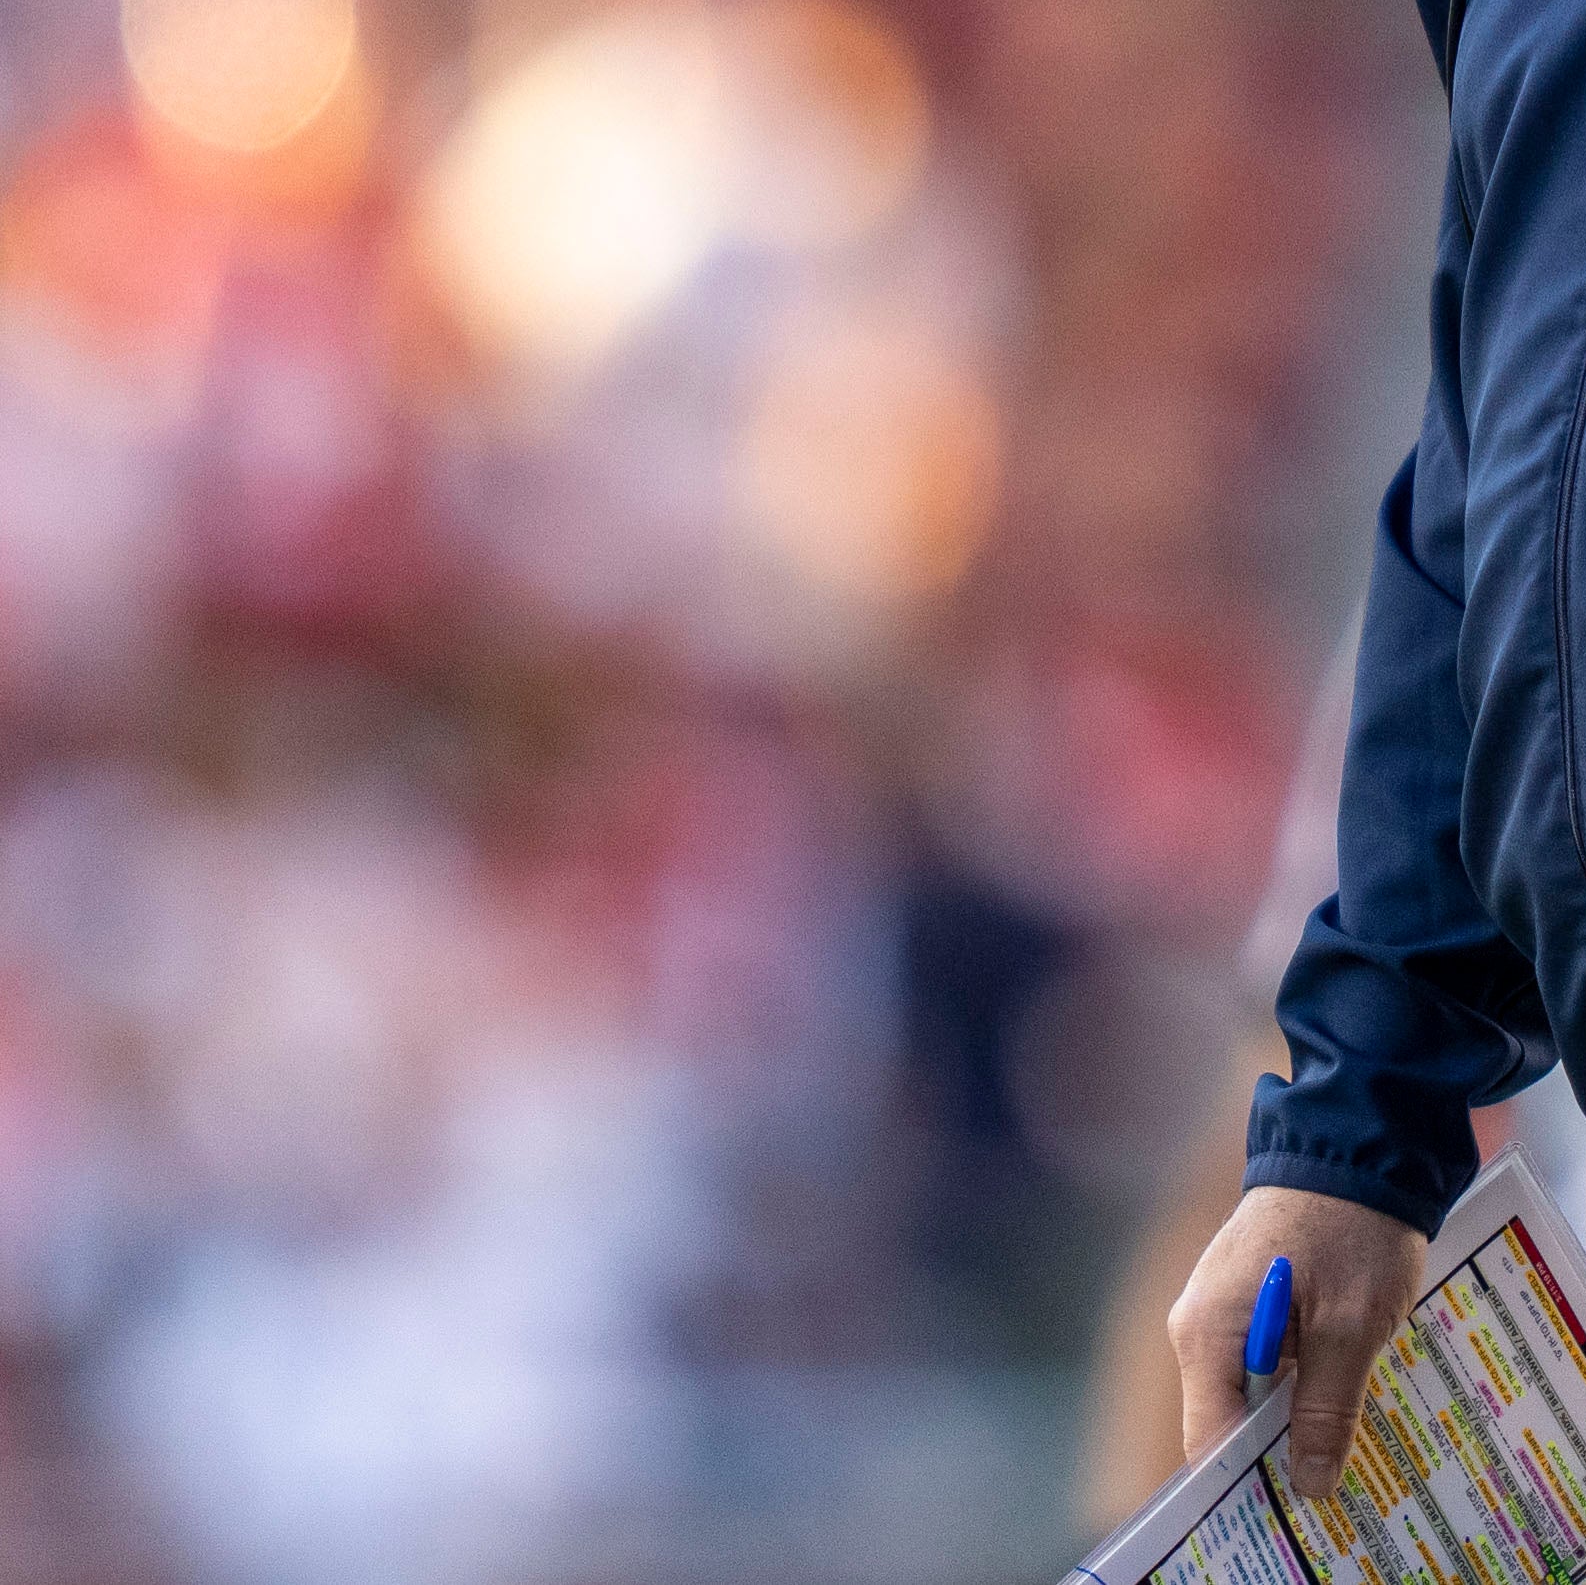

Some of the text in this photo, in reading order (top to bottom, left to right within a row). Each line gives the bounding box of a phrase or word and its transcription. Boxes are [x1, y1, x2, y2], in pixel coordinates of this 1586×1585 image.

[1518, 1288, 1532, 1304] HIP
[1496, 1307, 1519, 1337] ALERT
[1527, 1302, 1544, 1324] TUFF
[1437, 1360, 1459, 1390] ALERT
[1540, 1382, 1559, 1407] BEAT
[1372, 1413, 1393, 1443] ALERT
[1557, 1411, 1575, 1433] 20%
[1415, 1427, 1437, 1457] DEMON
[1483, 1440, 1502, 1466] BEAT
[1501, 1471, 1518, 1493] 63%
[1419, 1495, 1439, 1522] BEAT
[1512, 1490, 1544, 1538] PRESSURE
[1541, 1545, 1561, 1570] 7-11
